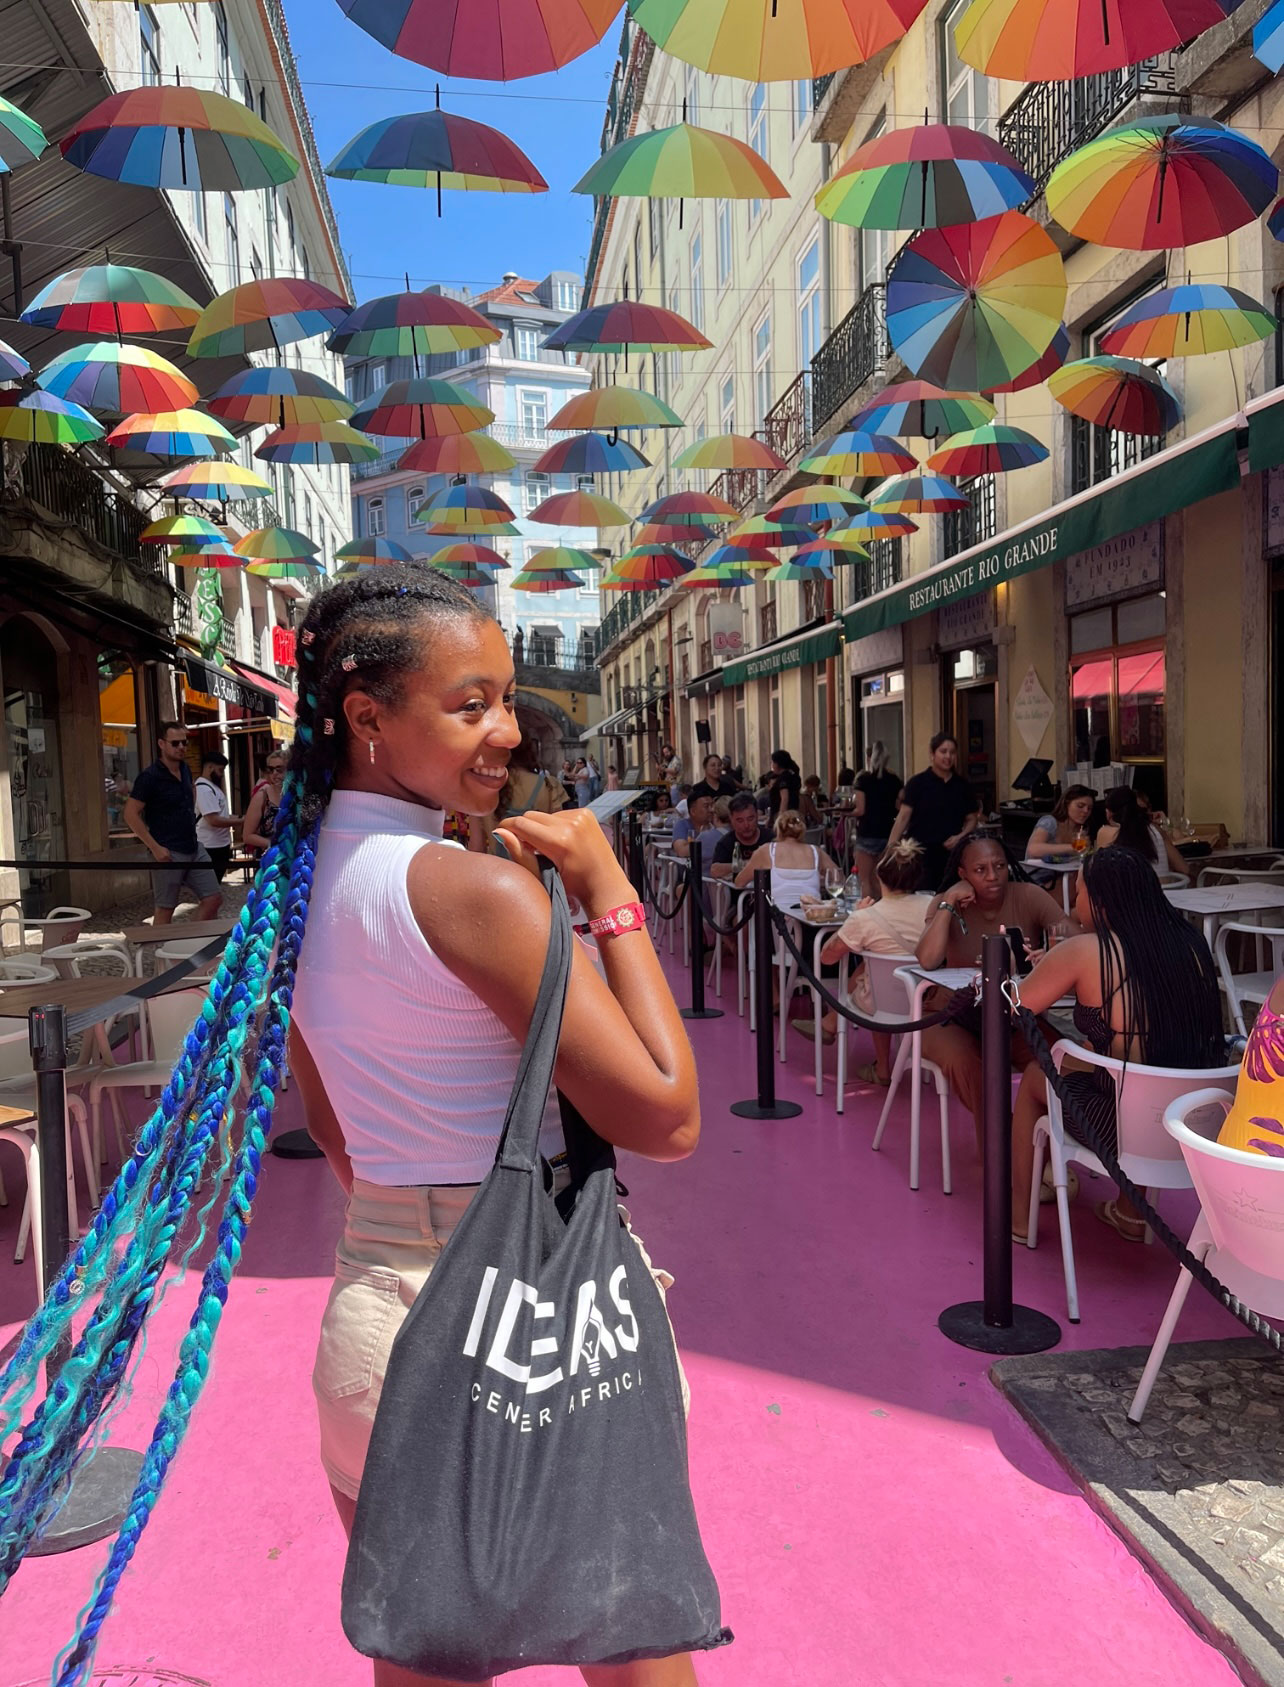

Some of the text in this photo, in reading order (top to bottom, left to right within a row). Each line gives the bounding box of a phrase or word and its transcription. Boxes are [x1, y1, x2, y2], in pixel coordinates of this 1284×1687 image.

[909, 528, 1057, 611] RESTAURANTE RIO GRANDE
[1084, 535, 1135, 565] FUNDADO
[471, 1369, 642, 1432] CENER AFRIC
